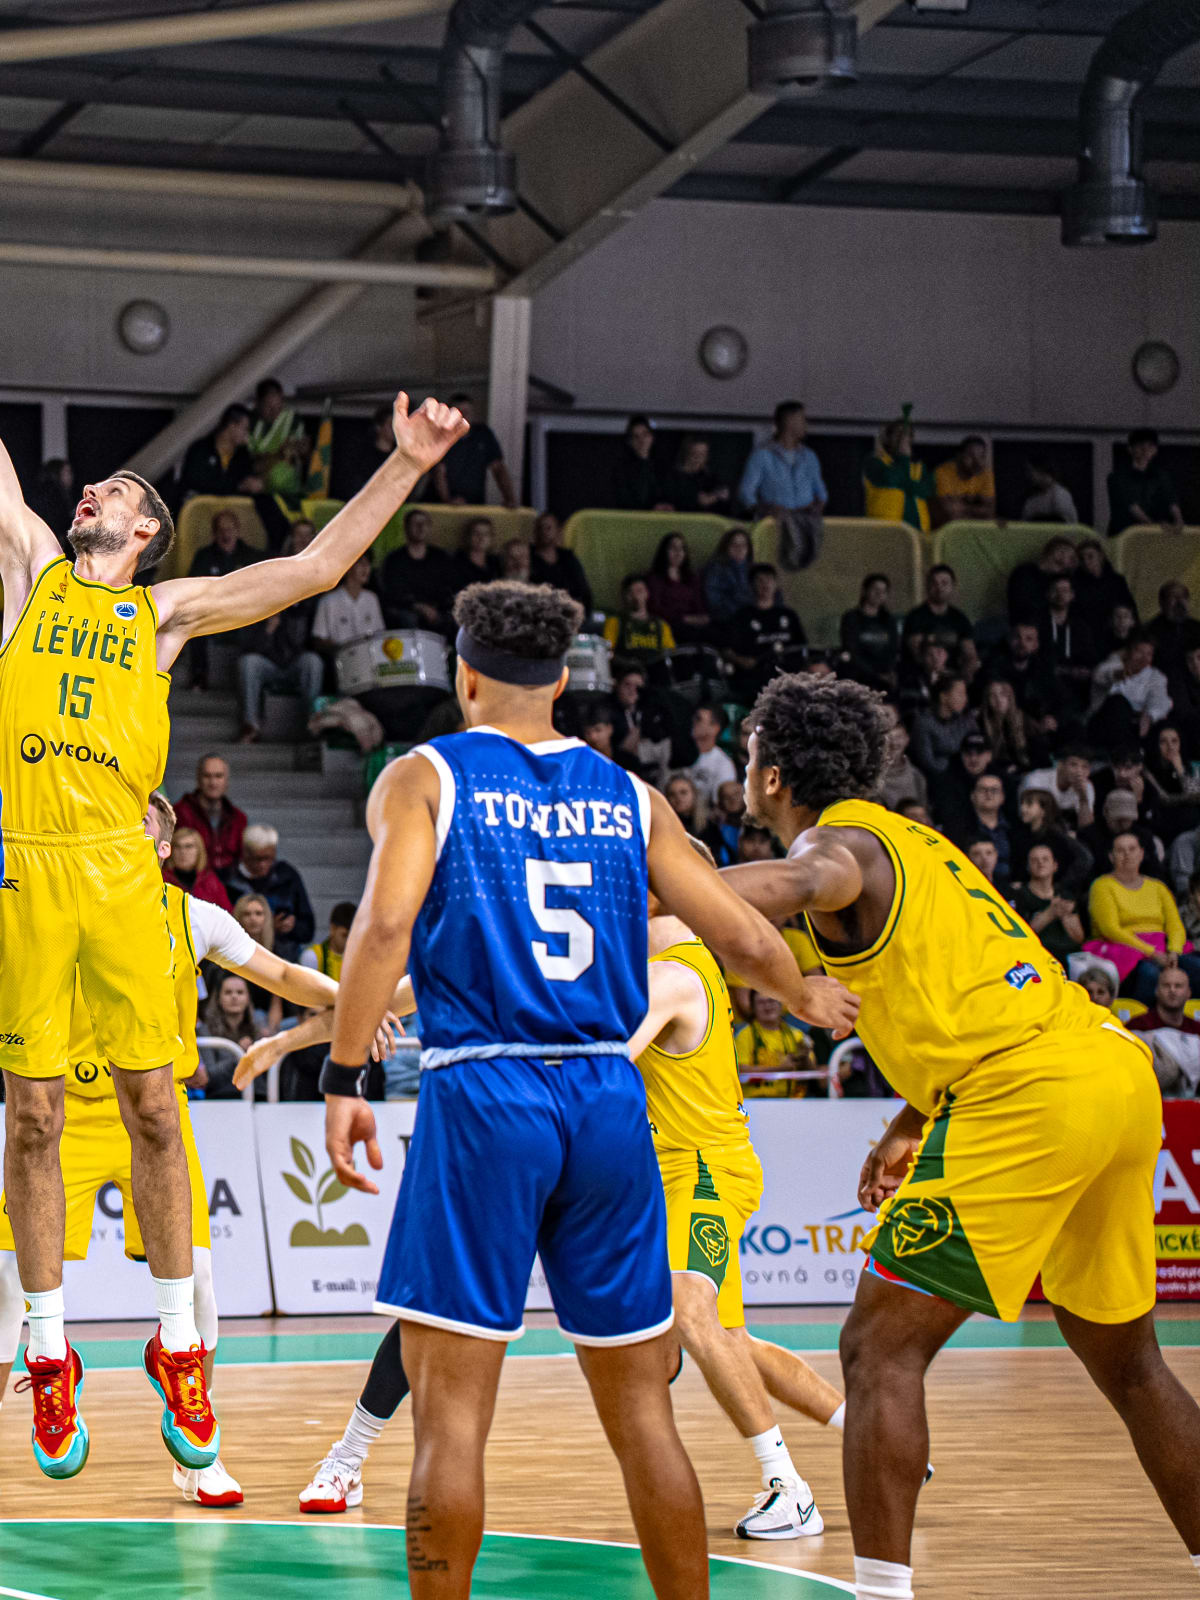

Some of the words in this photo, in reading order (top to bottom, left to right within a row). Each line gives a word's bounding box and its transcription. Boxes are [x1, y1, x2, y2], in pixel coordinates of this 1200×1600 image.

[32, 623, 136, 671] LEVICE
[58, 673, 95, 720] 15
[525, 857, 595, 982] 5
